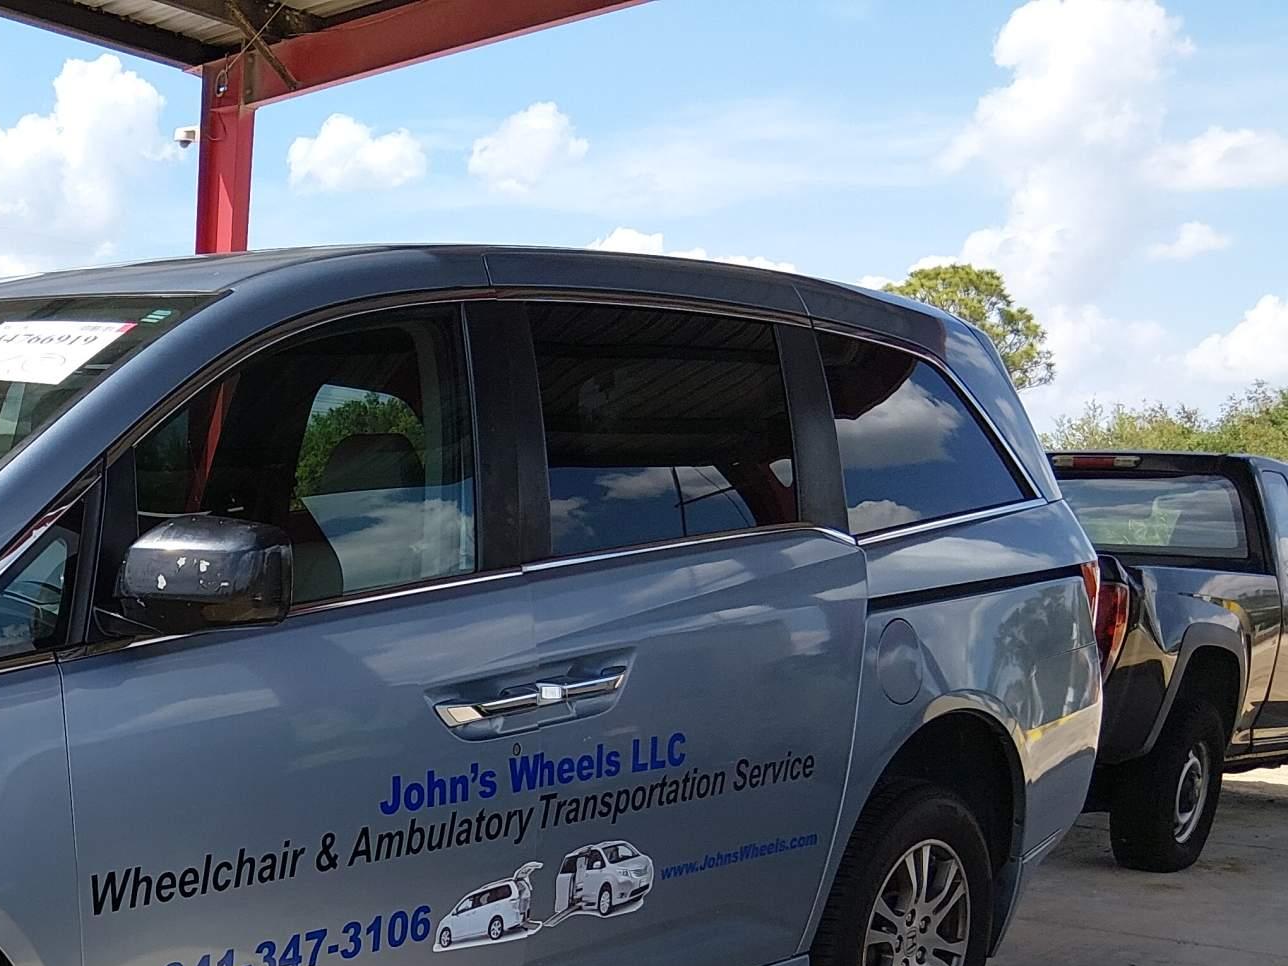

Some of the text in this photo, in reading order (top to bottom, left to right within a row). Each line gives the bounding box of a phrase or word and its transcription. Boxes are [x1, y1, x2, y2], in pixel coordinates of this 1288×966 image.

[379, 732, 687, 816] John's Wheels LLC
[90, 751, 816, 916] Wheelchair & Ambulatory Transportation Service
[661, 833, 818, 881] www.JohnsWheels.com
